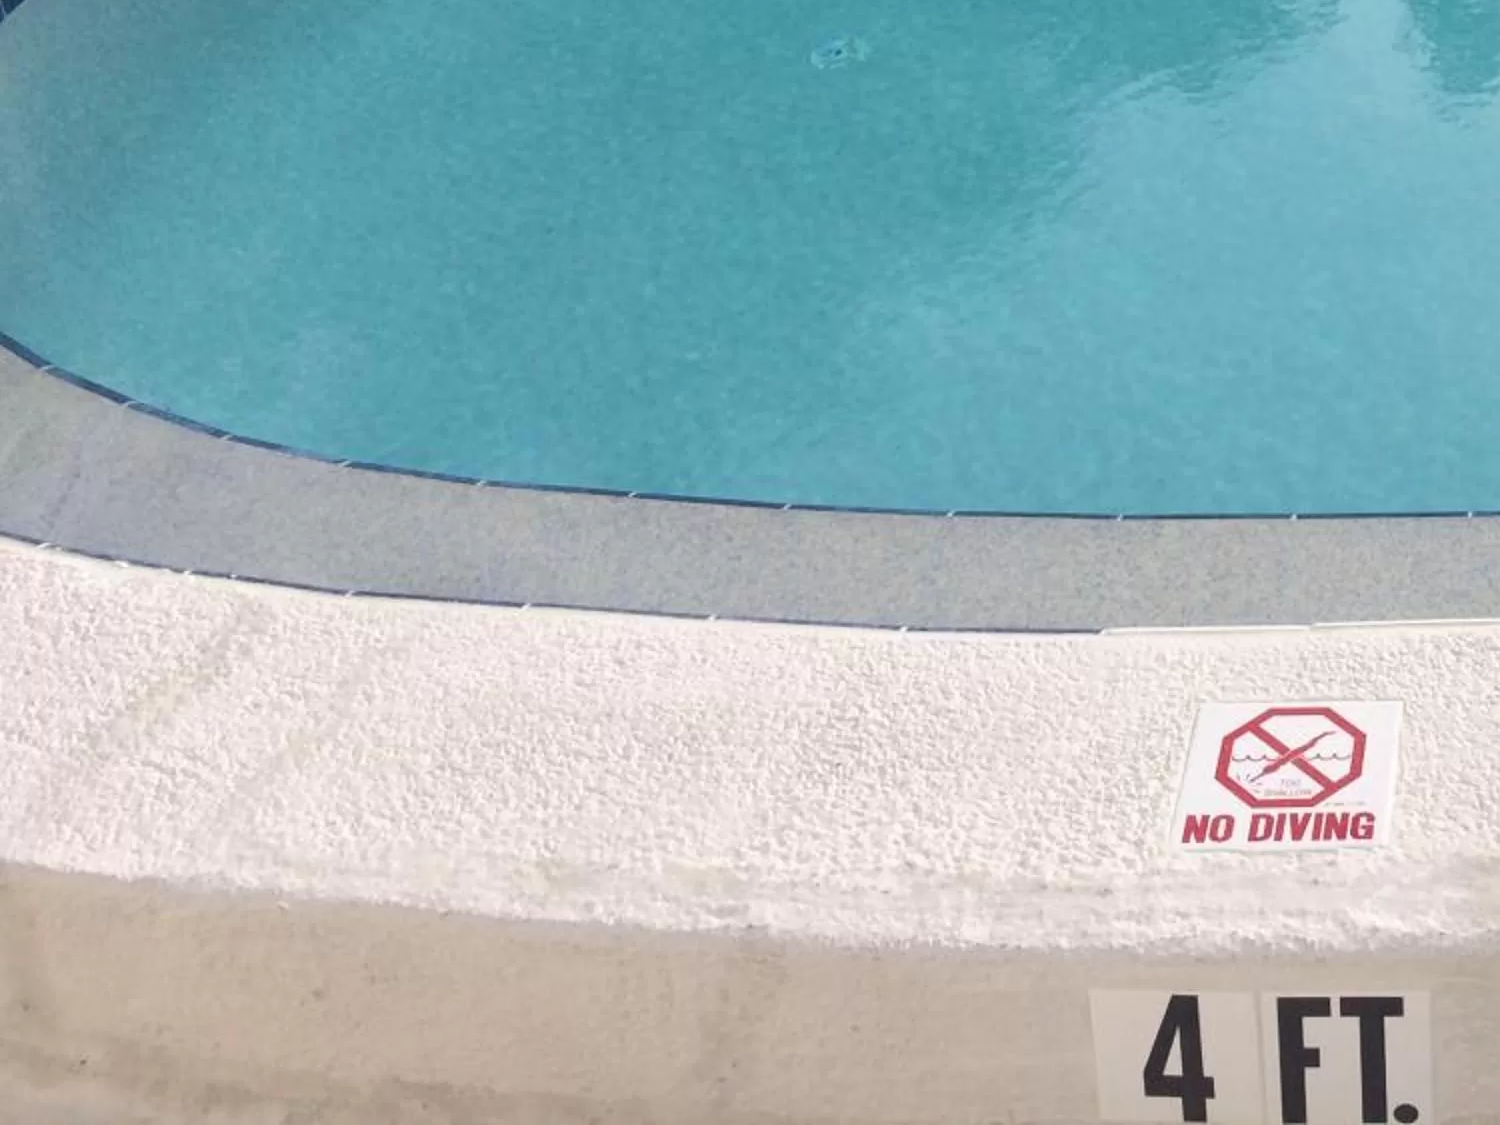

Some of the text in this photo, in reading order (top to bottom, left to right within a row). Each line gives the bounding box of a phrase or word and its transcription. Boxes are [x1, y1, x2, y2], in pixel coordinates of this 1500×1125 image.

[1181, 811, 1376, 843] NO DIVING
[1143, 994, 1419, 1124] 4 FT.
